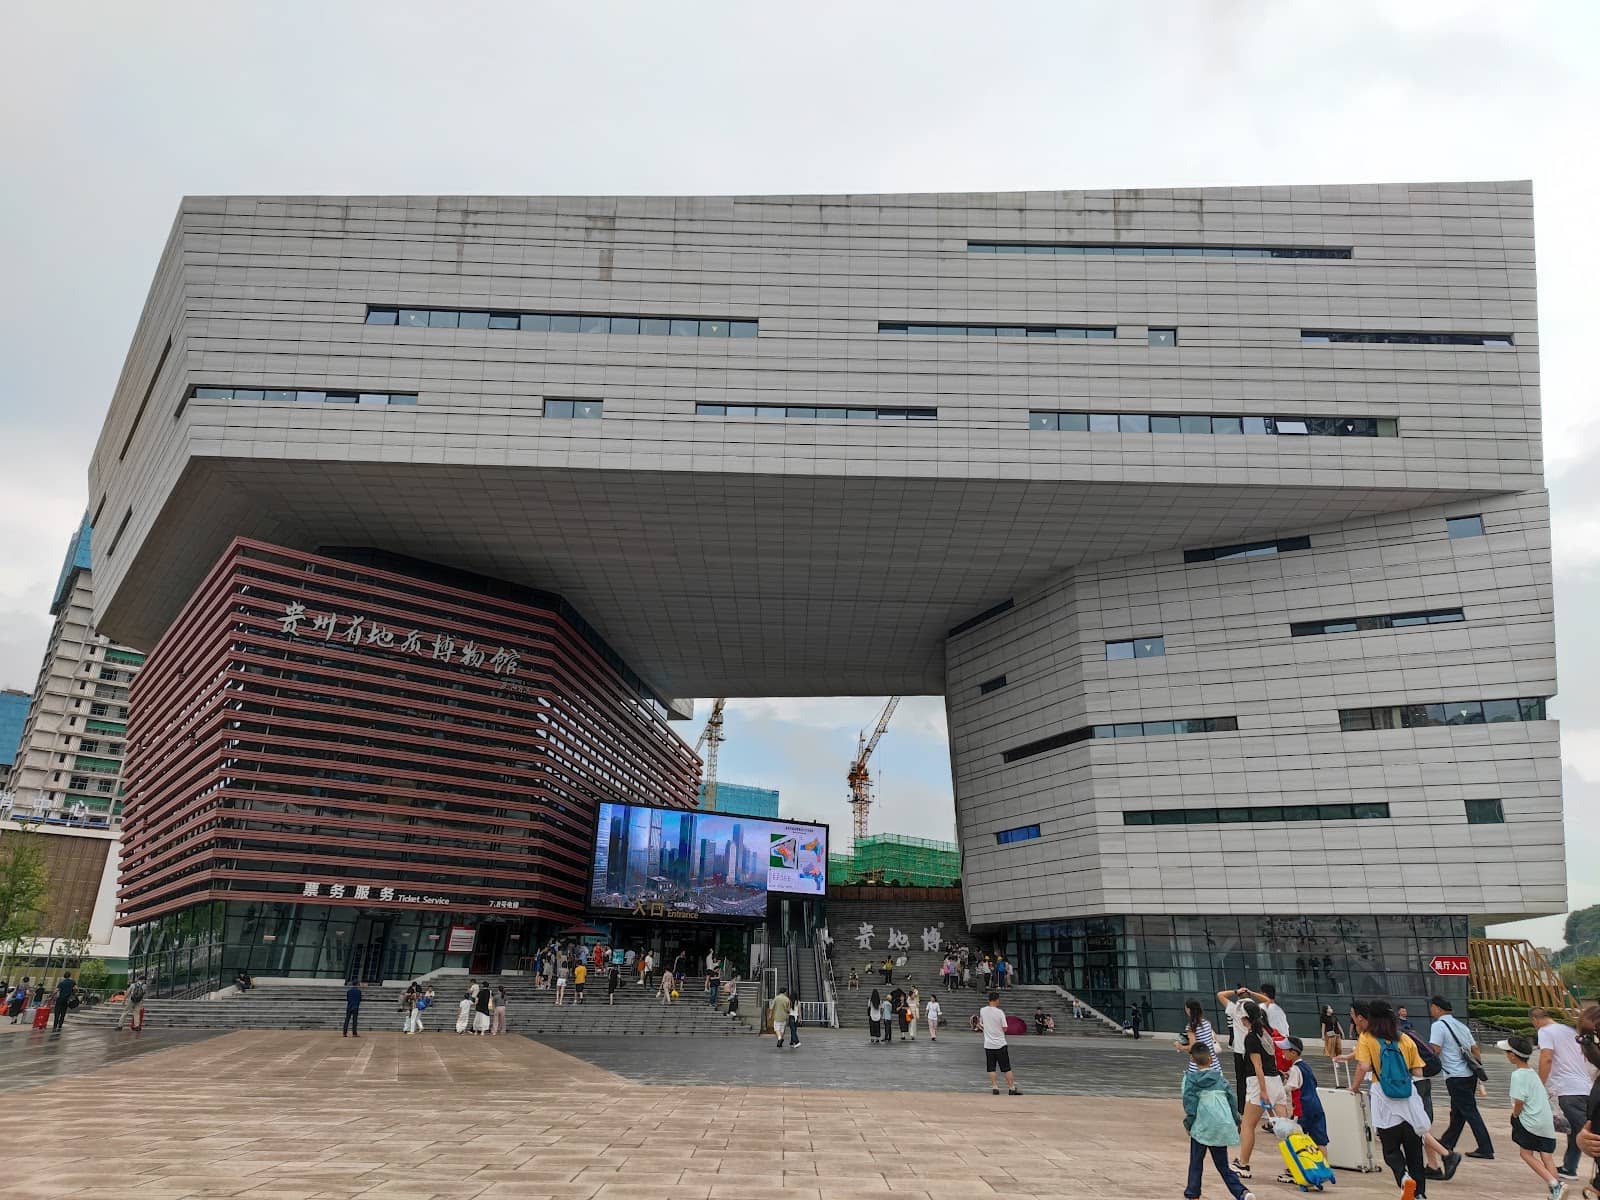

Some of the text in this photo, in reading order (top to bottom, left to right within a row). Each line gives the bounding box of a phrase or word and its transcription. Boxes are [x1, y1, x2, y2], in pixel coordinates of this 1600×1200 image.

[277, 600, 521, 675] 贵州省地质博物馆
[303, 882, 395, 901] 票务服务
[398, 894, 450, 905] Ticket Service
[632, 900, 665, 917] 入口
[667, 909, 699, 919] Entrance
[855, 922, 943, 952] 贵地博
[1435, 961, 1467, 970] 展厅入口
